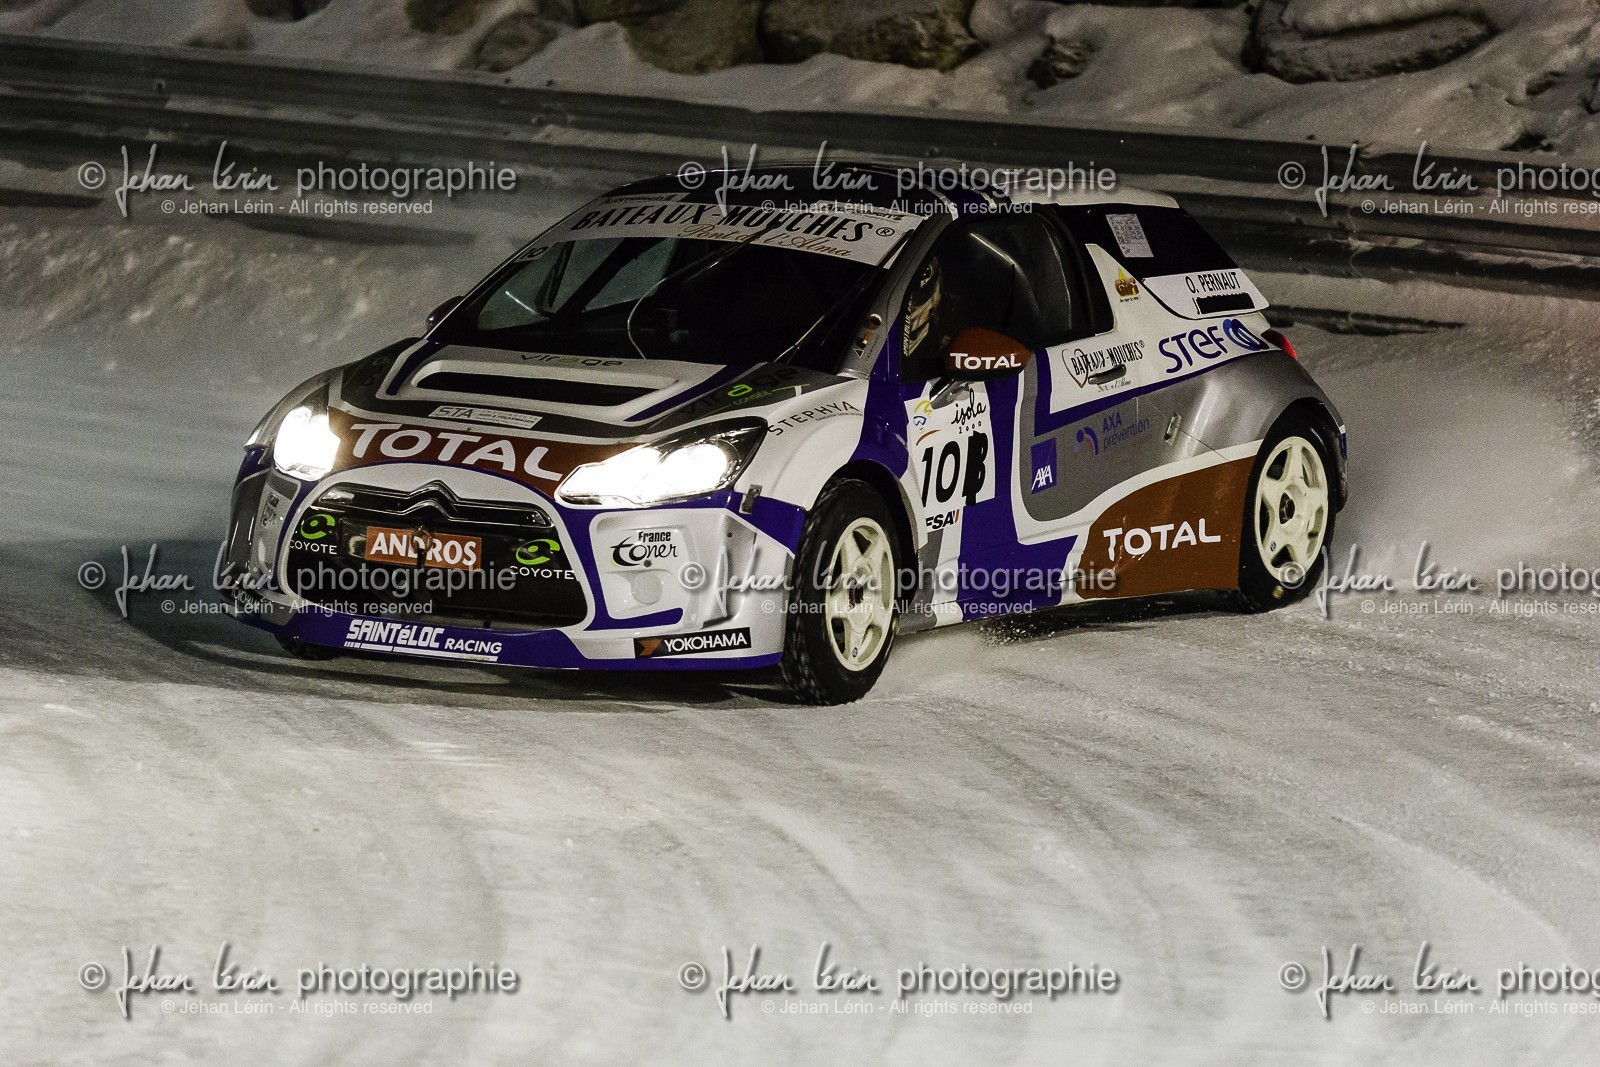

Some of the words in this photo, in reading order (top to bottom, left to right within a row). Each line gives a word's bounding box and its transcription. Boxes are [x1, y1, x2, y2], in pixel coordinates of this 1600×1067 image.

[1185, 276, 1199, 294] O.
[1200, 272, 1240, 292] PERNAUT
[521, 354, 624, 367] virage
[950, 353, 1022, 370] TOTAL
[439, 407, 474, 418] STA
[951, 388, 987, 425] isola
[768, 400, 860, 436] STEPHYA
[958, 421, 982, 435] 2000
[1103, 411, 1122, 434] AXA
[1103, 417, 1150, 450] prévention
[350, 423, 563, 480] TOTAL
[1031, 464, 1053, 491] AXA
[638, 531, 671, 543] France
[1103, 518, 1221, 561] TOTAL
[610, 536, 678, 567] toner
[509, 565, 575, 580] COYOTE
[444, 638, 502, 655] RACING
[664, 632, 747, 652] YOKOHAMA
